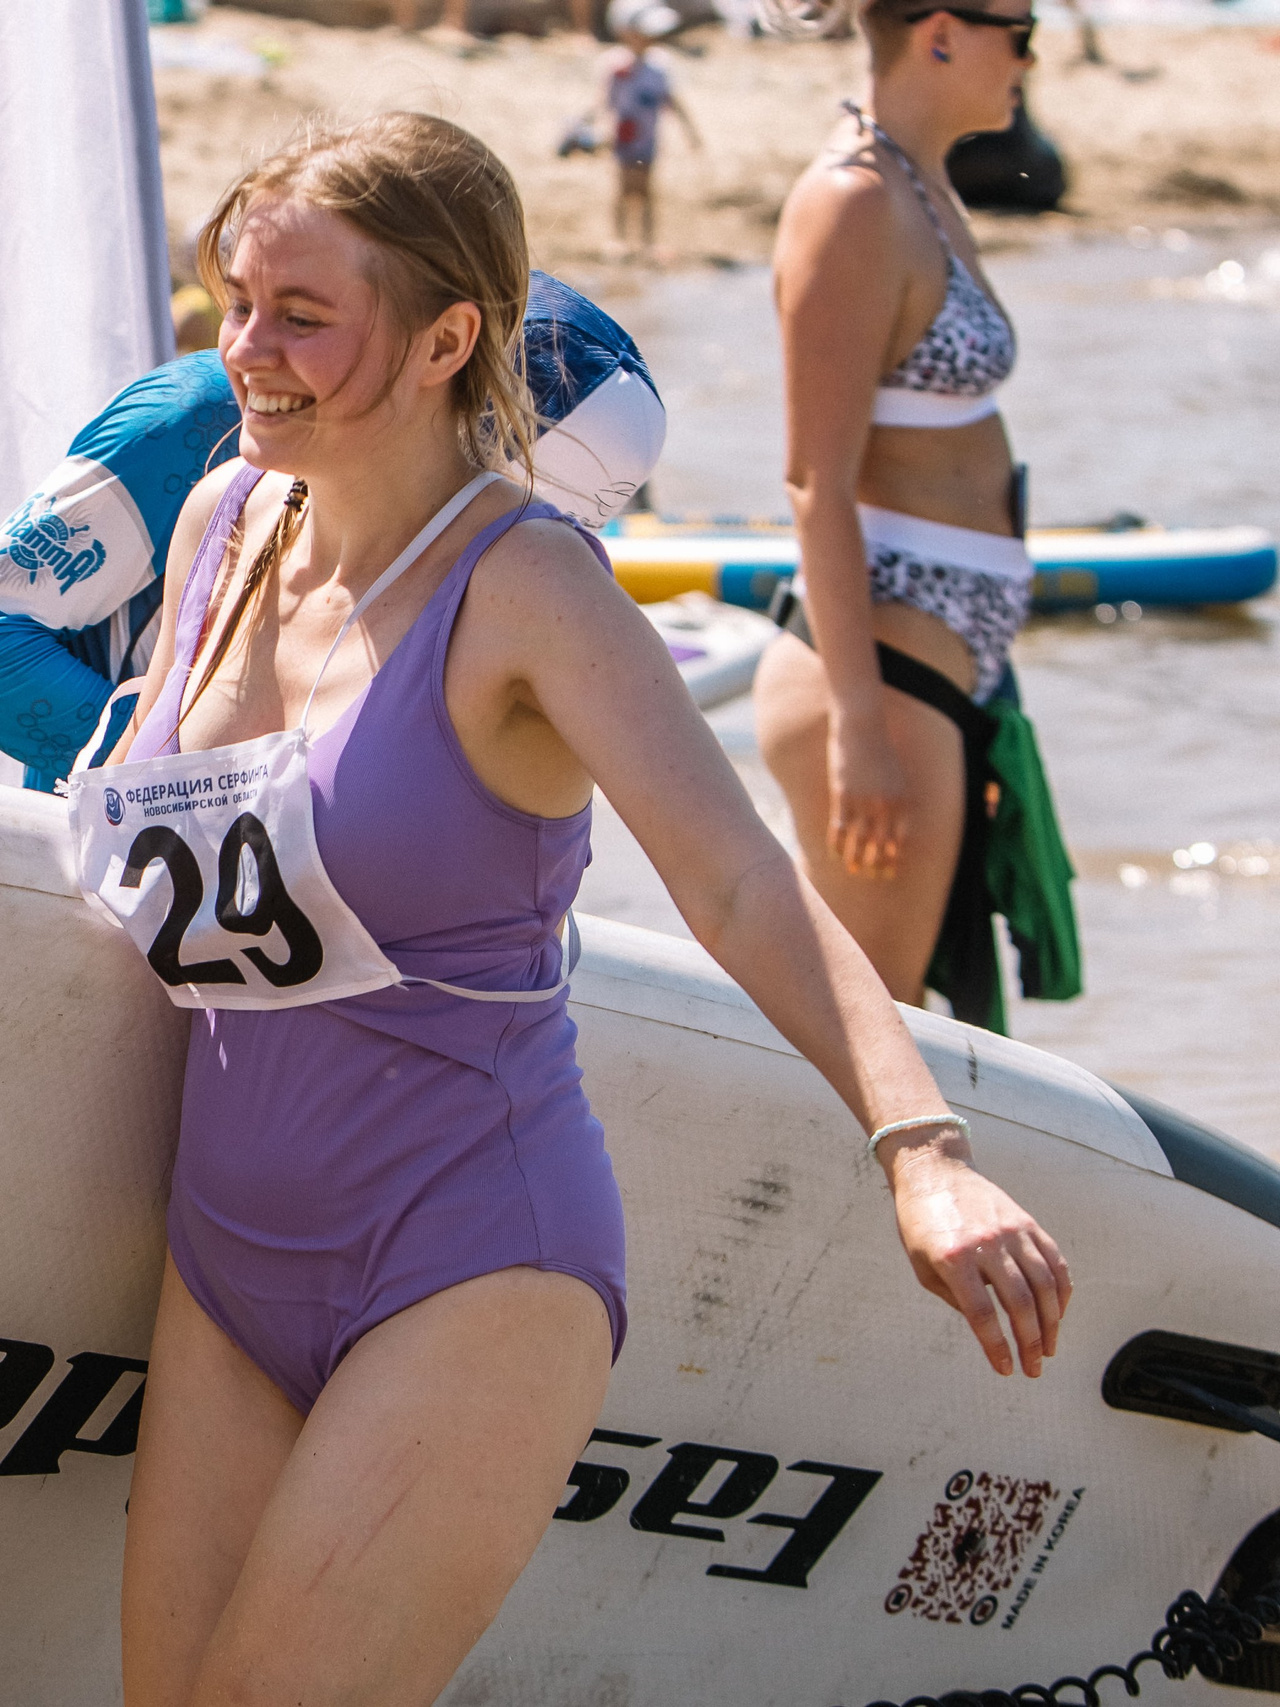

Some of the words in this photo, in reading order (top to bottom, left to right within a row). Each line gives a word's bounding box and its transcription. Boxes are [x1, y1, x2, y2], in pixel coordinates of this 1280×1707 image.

[125, 776, 214, 807] ФЕДЕРАЦИЯ
[217, 763, 269, 791] СЕРФИНГА
[143, 793, 229, 818] НОВОСИБИРСКОЙ
[232, 788, 259, 805] ОБЛАСТИ
[118, 811, 325, 988] 29
[1000, 1576, 1038, 1631] MADE
[1030, 1554, 1050, 1574] IN
[1043, 1486, 1087, 1552] KOREA
